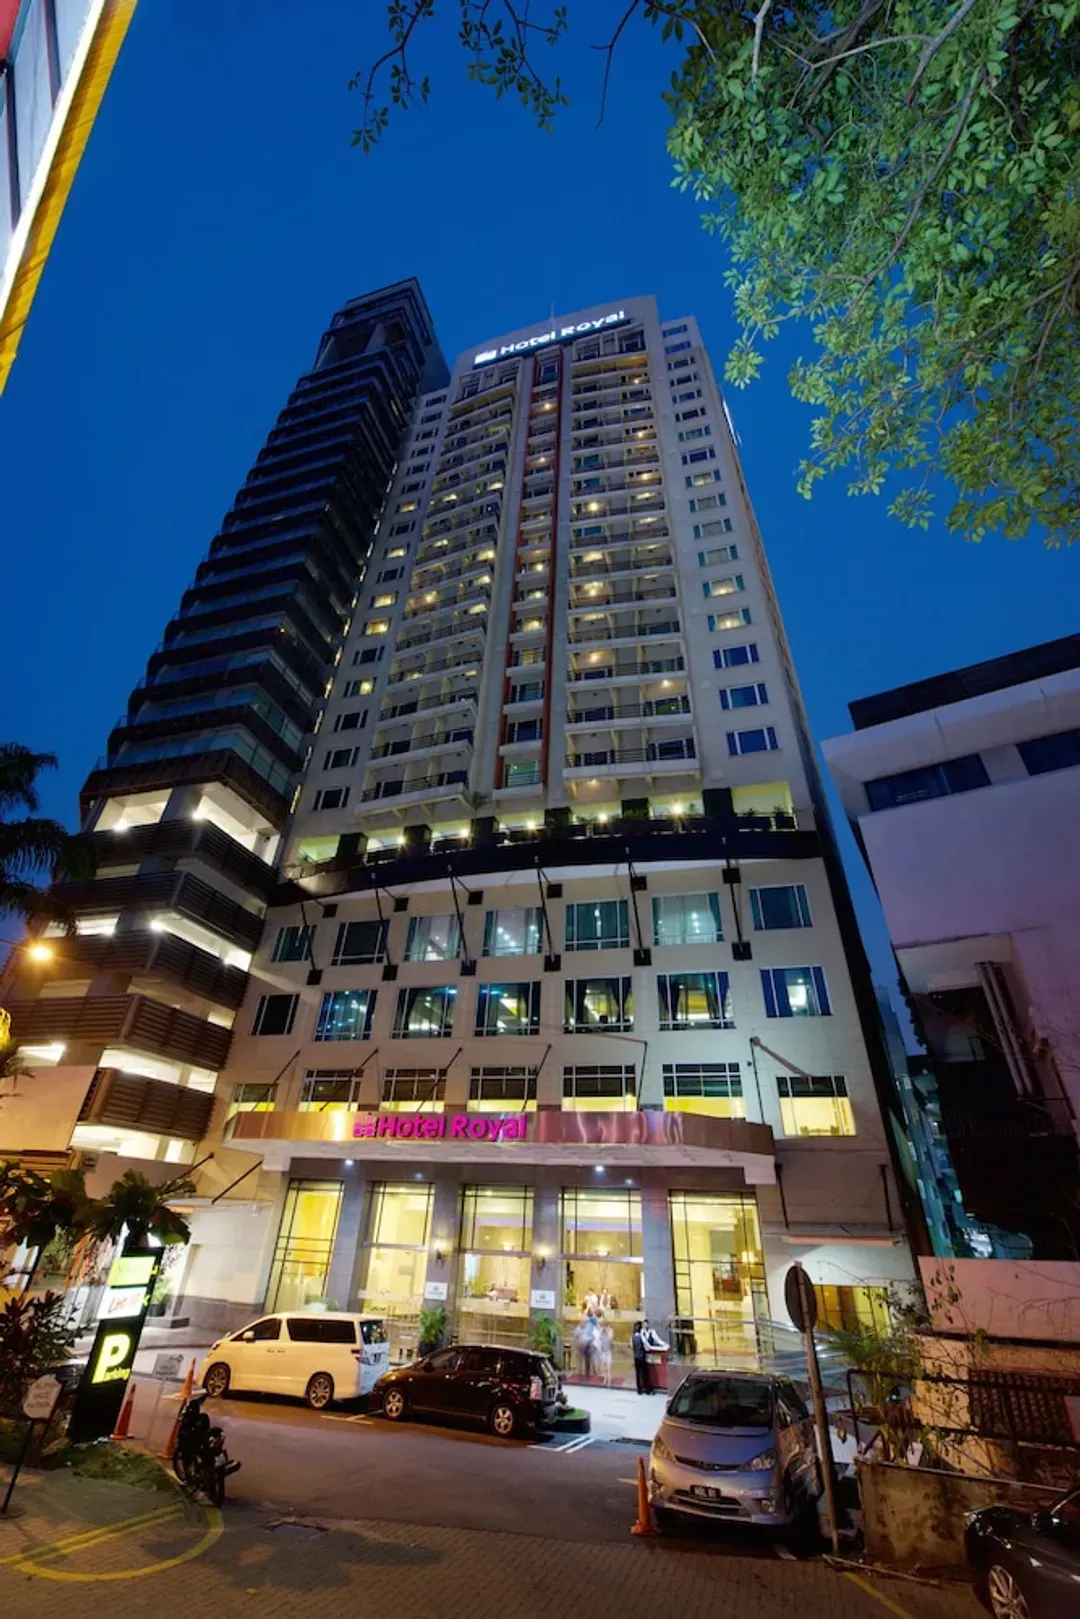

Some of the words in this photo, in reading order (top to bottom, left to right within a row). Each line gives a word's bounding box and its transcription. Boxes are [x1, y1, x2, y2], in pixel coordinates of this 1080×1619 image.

[500, 331, 556, 355] Hotel
[560, 310, 625, 337] Royal
[378, 1115, 446, 1138] Hotel
[451, 1114, 527, 1142] Royal
